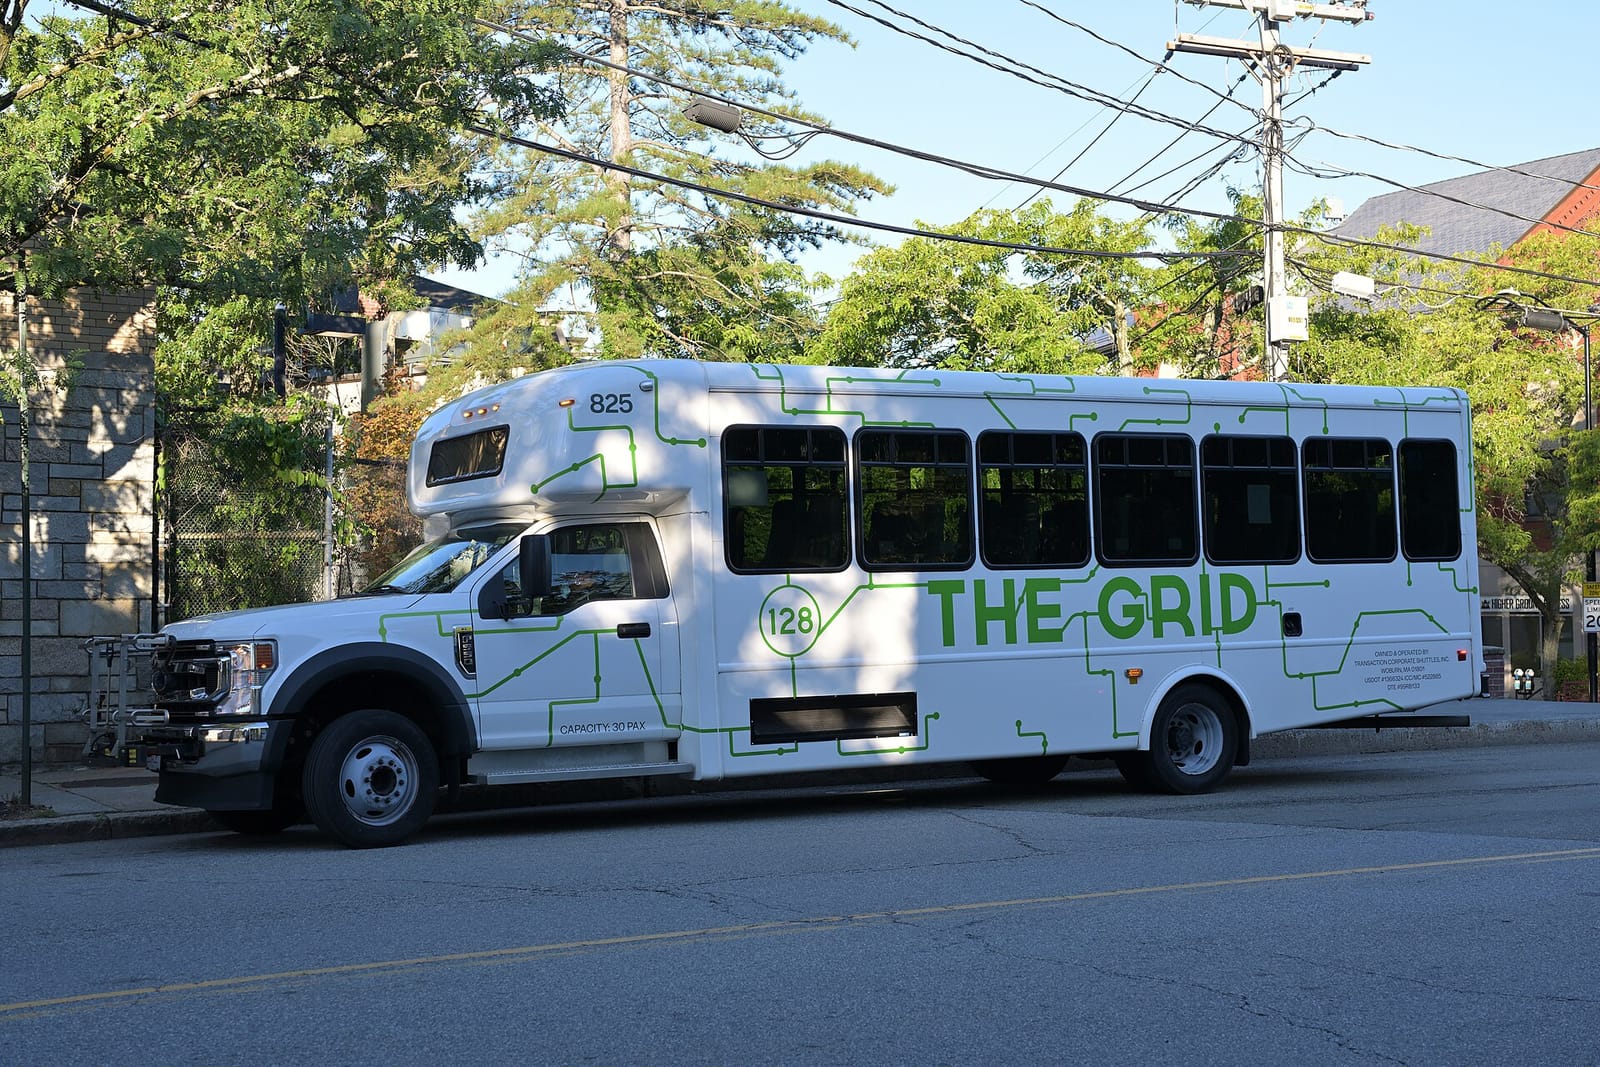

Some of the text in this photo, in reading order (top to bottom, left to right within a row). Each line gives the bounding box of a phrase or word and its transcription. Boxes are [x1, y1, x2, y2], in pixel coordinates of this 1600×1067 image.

[590, 393, 633, 414] 825
[927, 573, 1258, 648] THE GRID
[1491, 598, 1514, 609] HIGHER
[769, 607, 814, 635] 128
[1354, 658, 1388, 667] TRANSACTION
[1388, 657, 1417, 666] CORPORATE
[560, 721, 646, 735] CAPACITY: 30 PAX
